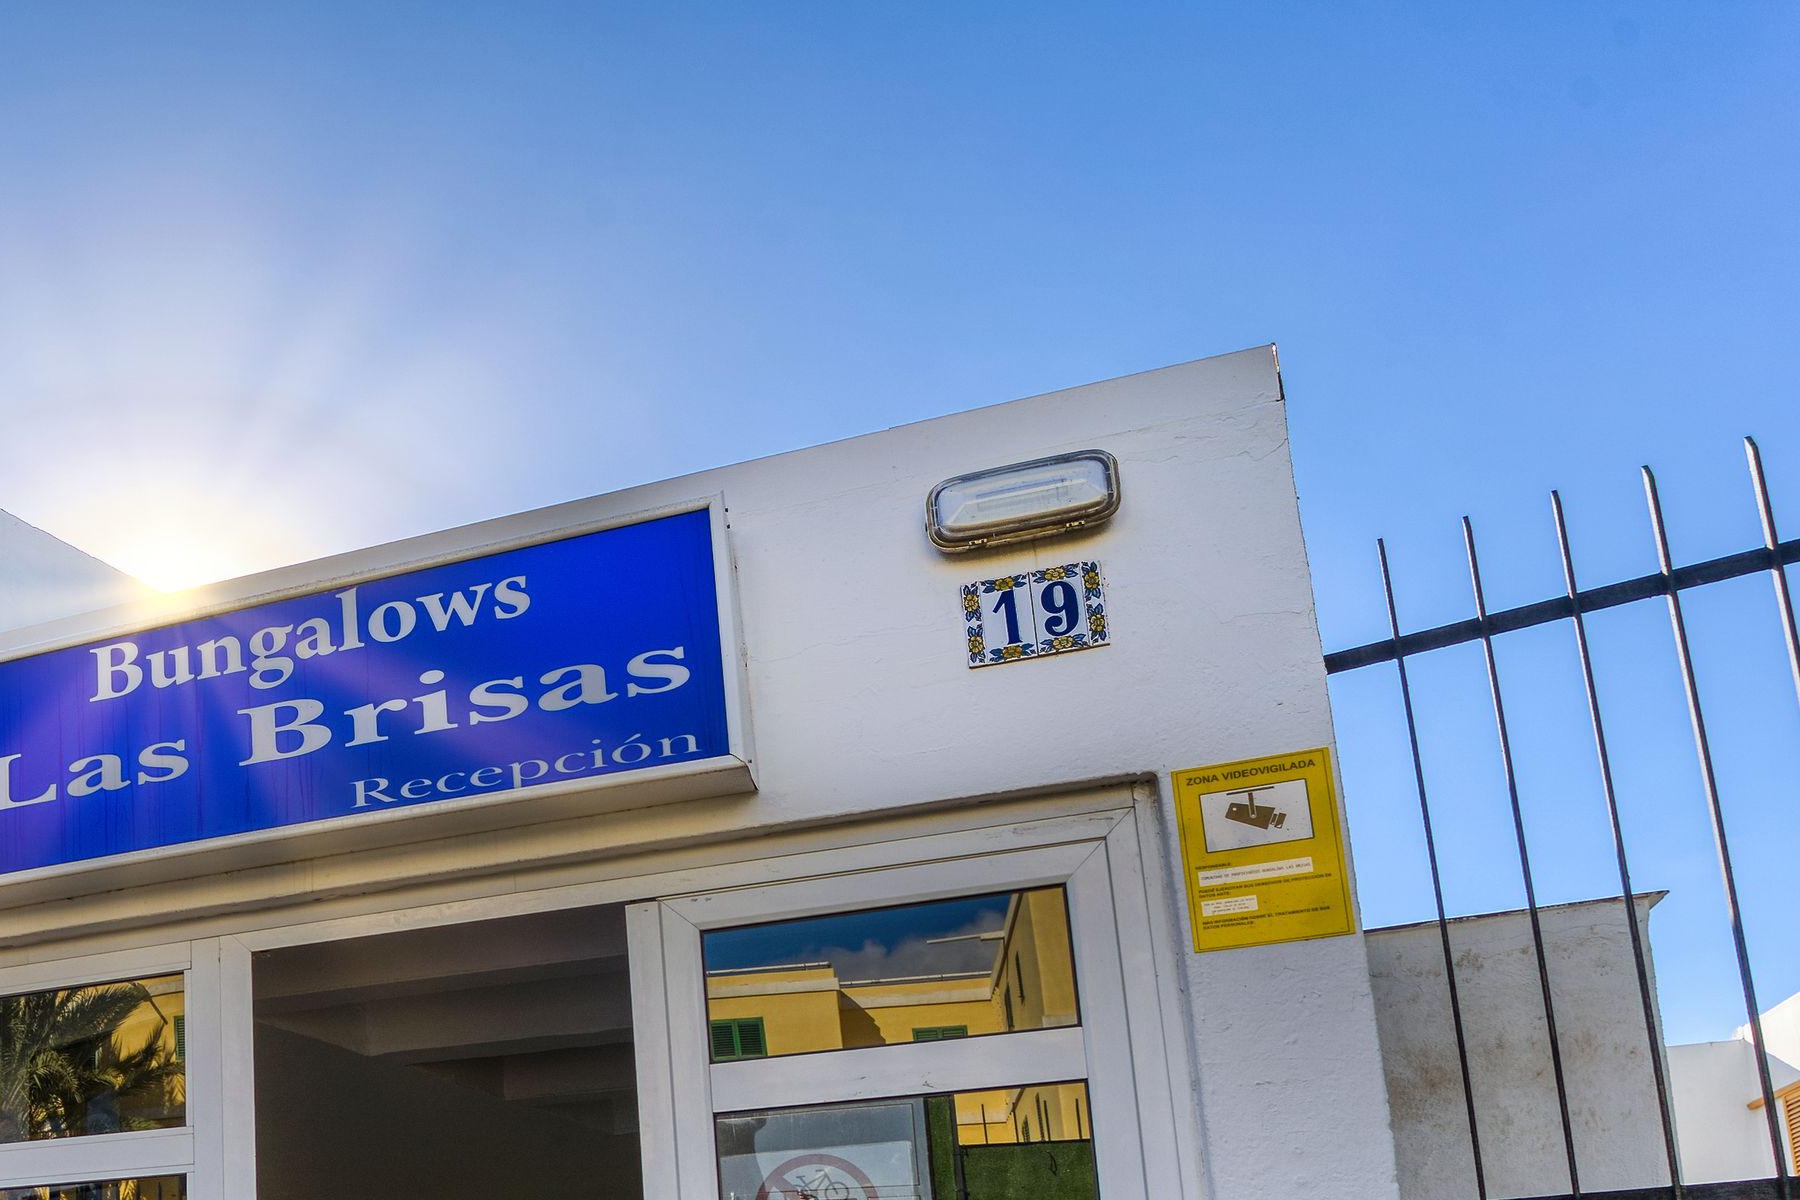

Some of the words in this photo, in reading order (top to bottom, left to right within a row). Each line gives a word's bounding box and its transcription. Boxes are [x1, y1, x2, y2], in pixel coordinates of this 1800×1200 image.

[88, 574, 531, 704] Bungalows
[993, 581, 1079, 645] 19
[238, 645, 692, 767] Brisas
[350, 732, 702, 809] Recepción
[1186, 774, 1219, 786] ZONA
[1223, 759, 1316, 781] VIDEOVIGILADA
